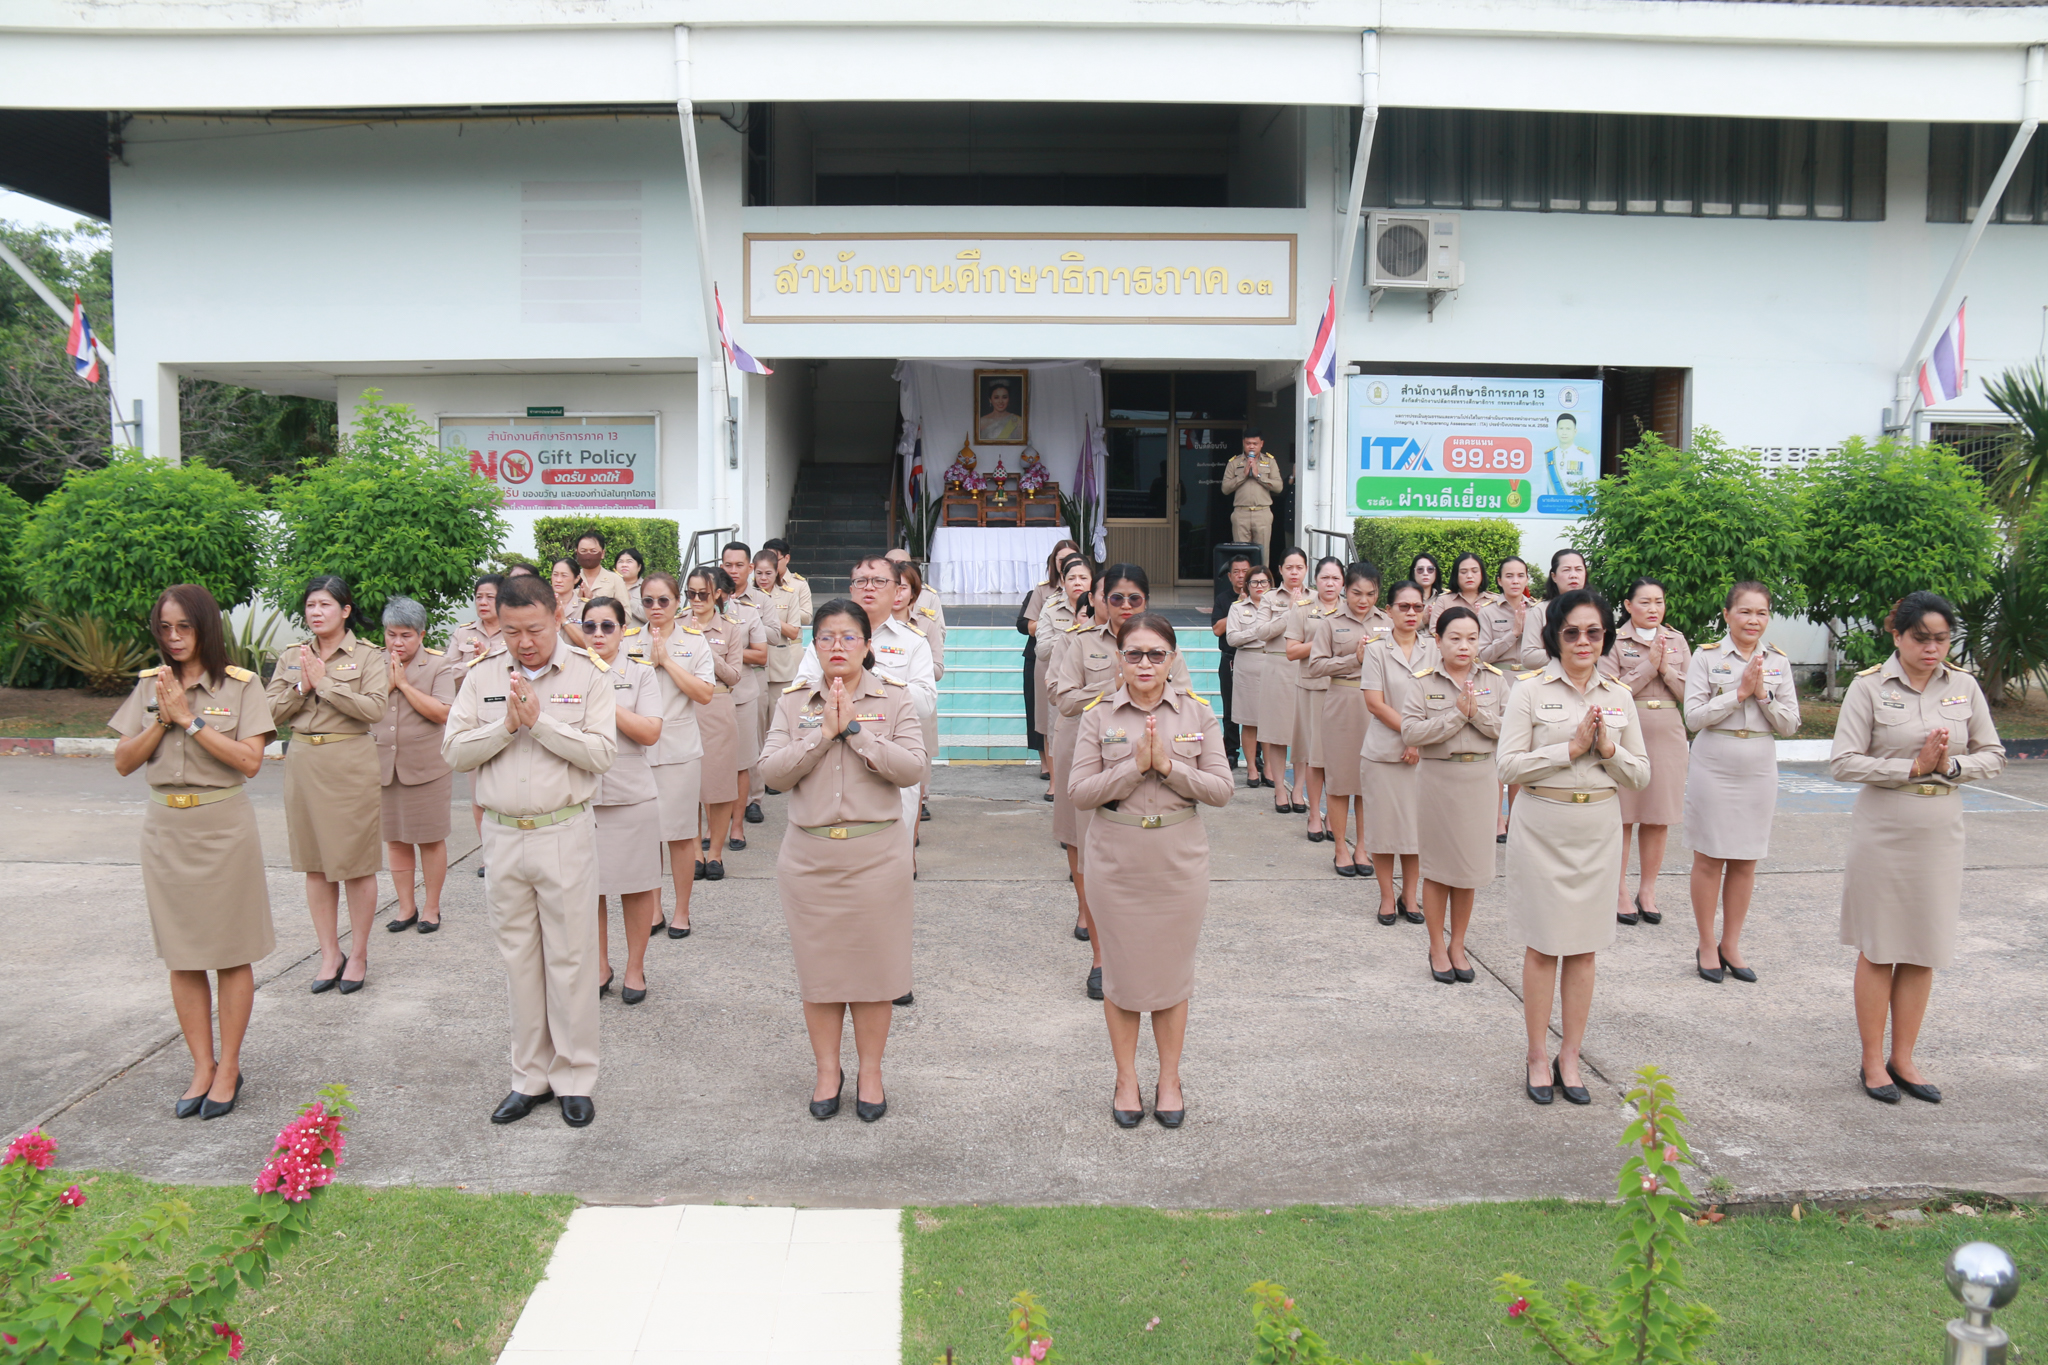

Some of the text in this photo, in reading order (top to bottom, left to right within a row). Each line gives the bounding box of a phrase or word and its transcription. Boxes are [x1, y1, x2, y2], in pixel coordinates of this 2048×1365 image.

[773, 248, 1274, 297] สำนักงานศึกษาธิการภาค ๑๓
[1401, 384, 1546, 399] สำนักงานศึกษาธิการภาค 13
[487, 431, 618, 441] สำนักงานศึกษาธิการภาค 13
[1453, 437, 1494, 447] ผลคะแนน
[538, 449, 637, 467] Gift Policy
[1360, 435, 1434, 471] ITA
[1451, 447, 1526, 470] 99.89
[554, 469, 621, 484] งดรับ งดให้
[522, 489, 558, 499] ของขวัญ
[1398, 482, 1502, 511] ผ่านดีเยี่ยม
[1366, 497, 1393, 508] ระดับ
